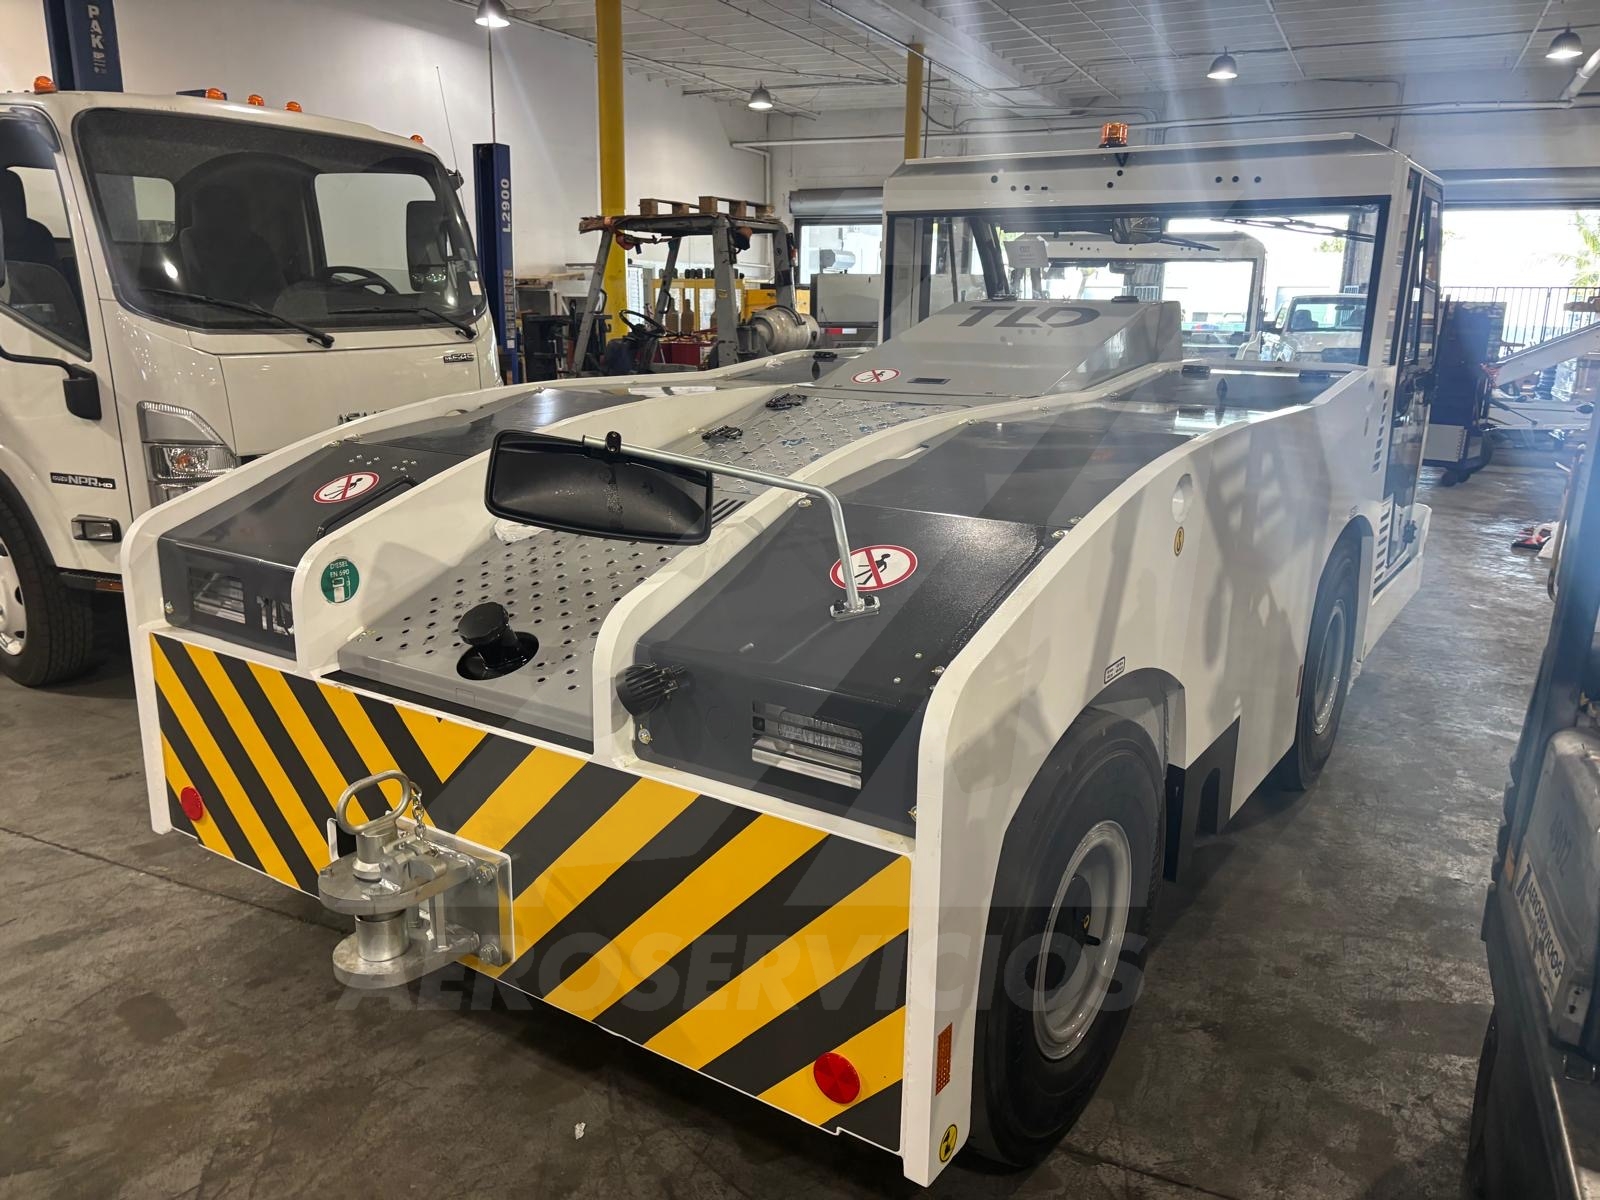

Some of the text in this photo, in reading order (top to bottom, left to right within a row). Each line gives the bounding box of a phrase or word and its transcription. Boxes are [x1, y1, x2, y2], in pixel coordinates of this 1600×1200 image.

[500, 178, 511, 233] L2900
[958, 305, 1101, 329] TLD
[330, 560, 349, 569] DIESEL
